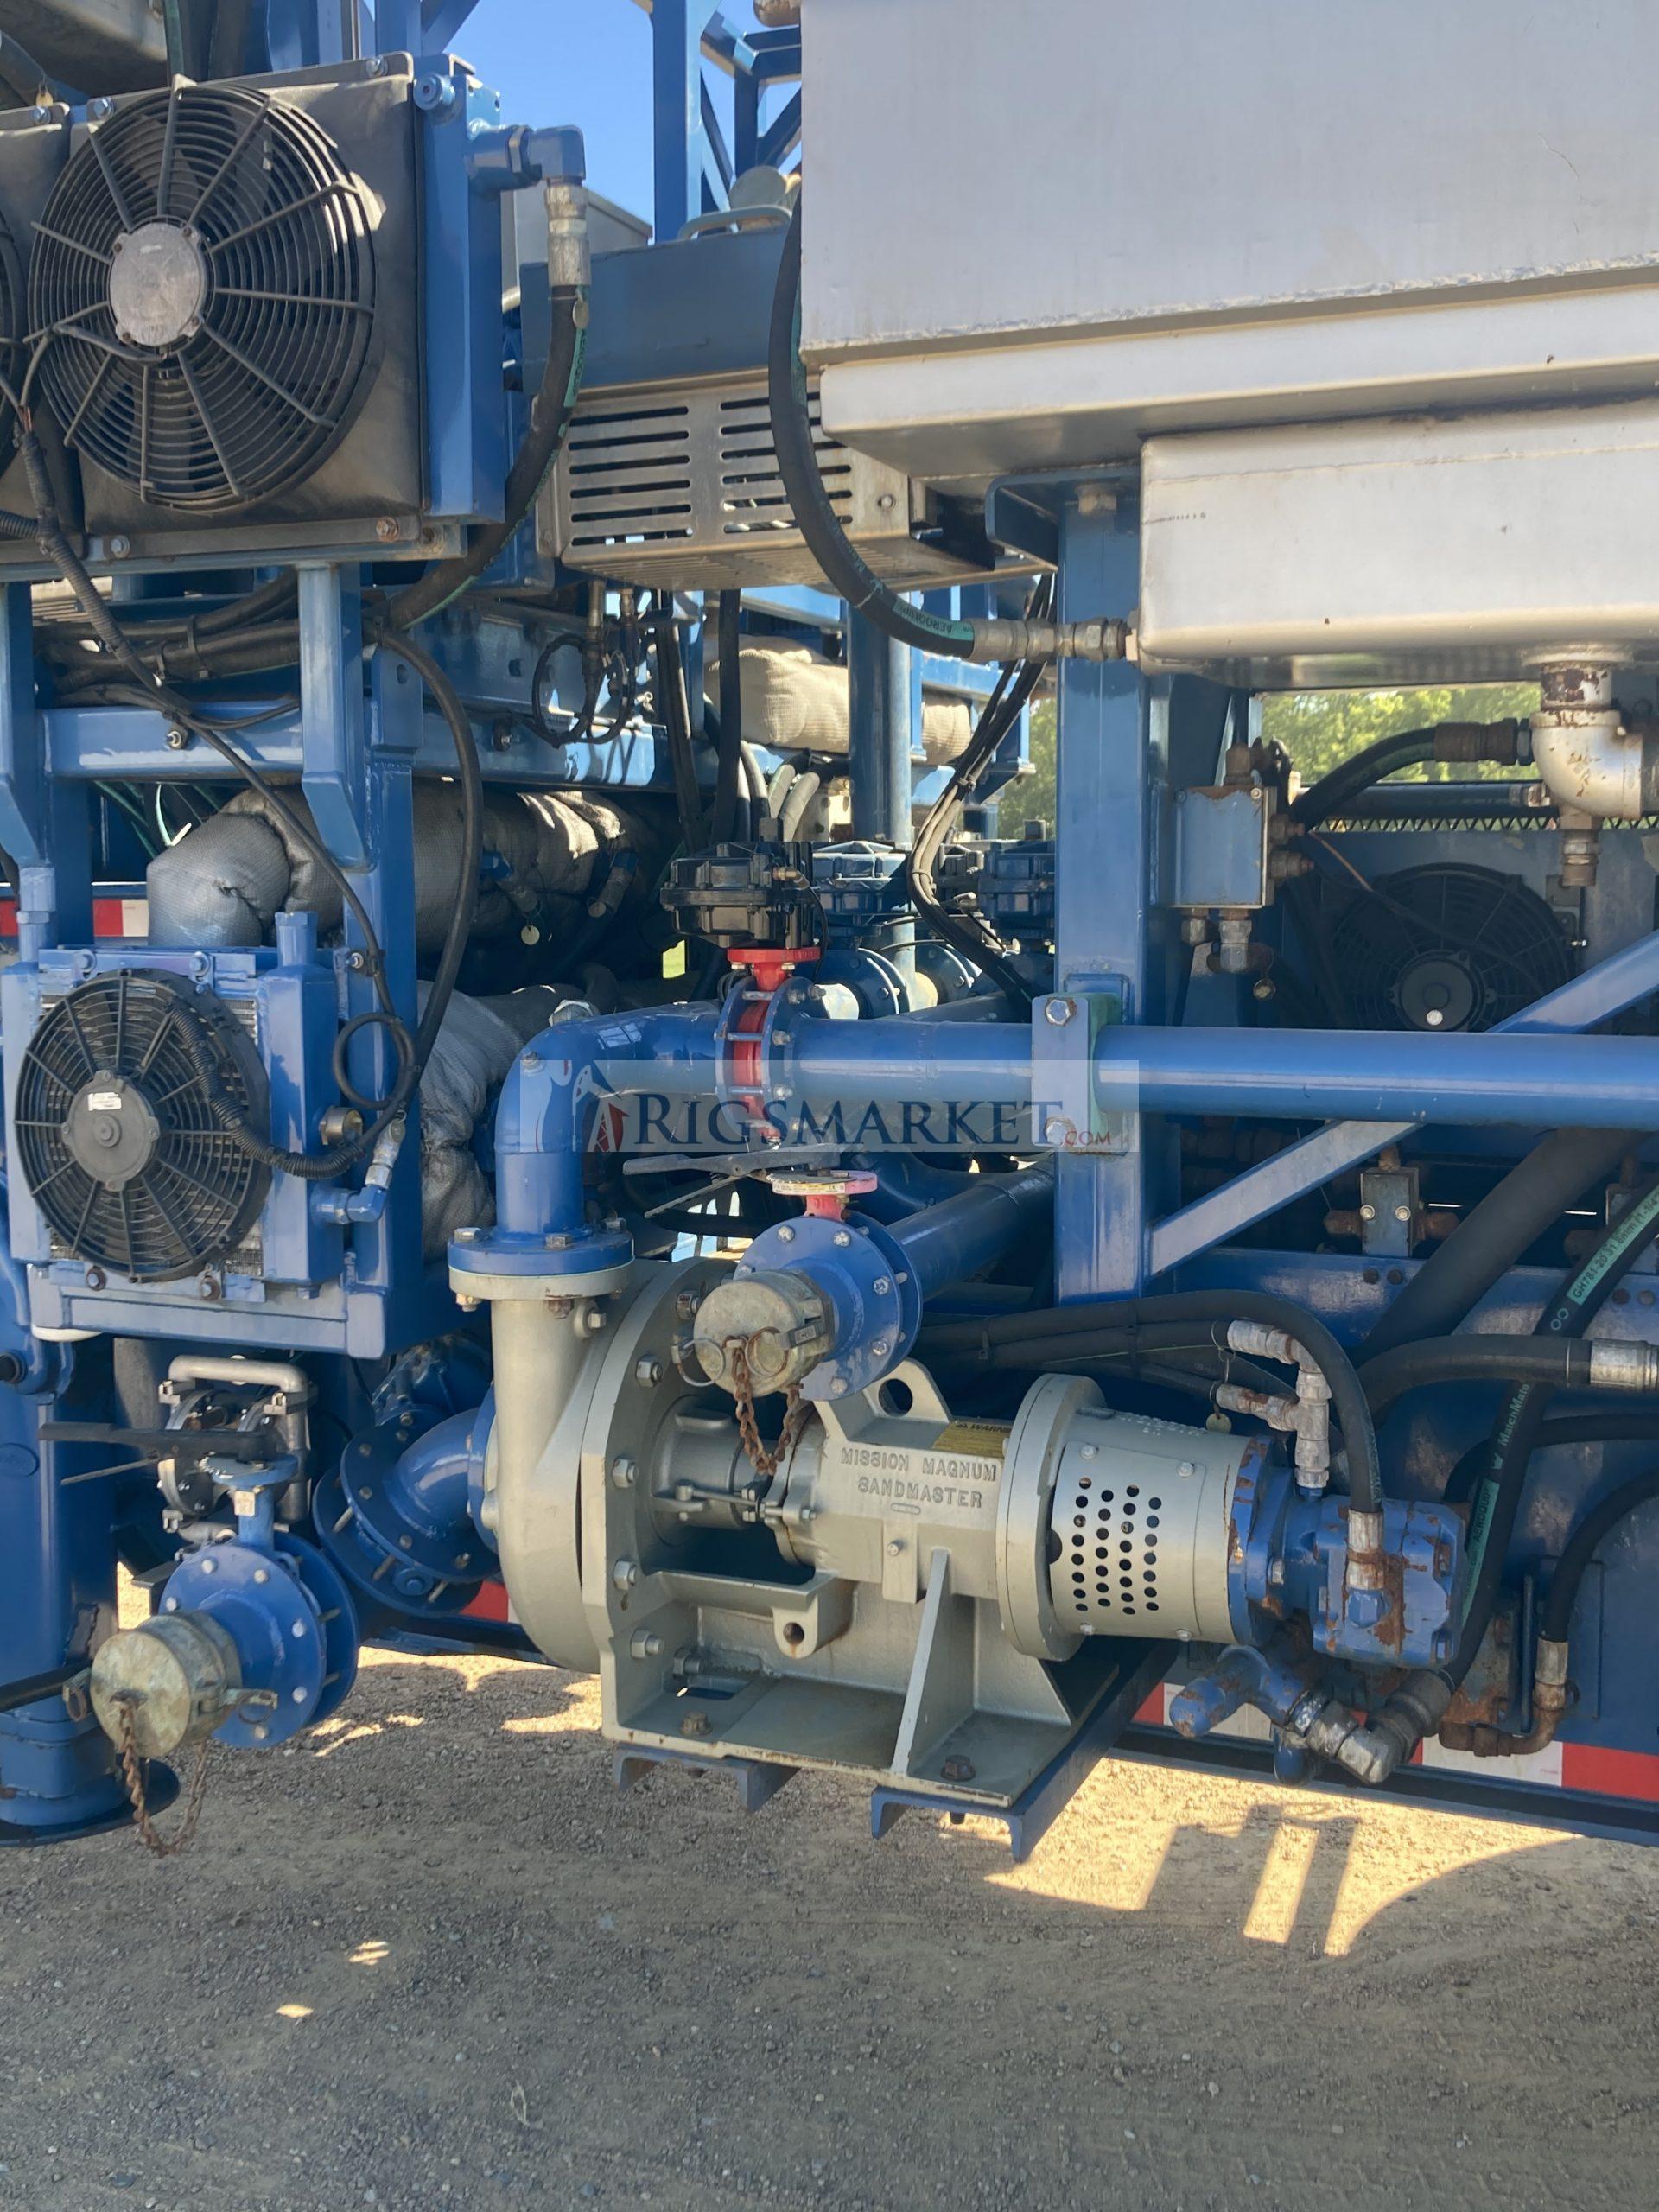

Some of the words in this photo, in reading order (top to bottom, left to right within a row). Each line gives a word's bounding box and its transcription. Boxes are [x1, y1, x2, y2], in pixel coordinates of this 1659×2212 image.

[1573, 1250, 1608, 1298] GH781-20
[841, 1447, 909, 1472] MISSION
[922, 1458, 996, 1482] MAGNUM
[857, 1477, 982, 1508] SANDMASTER
